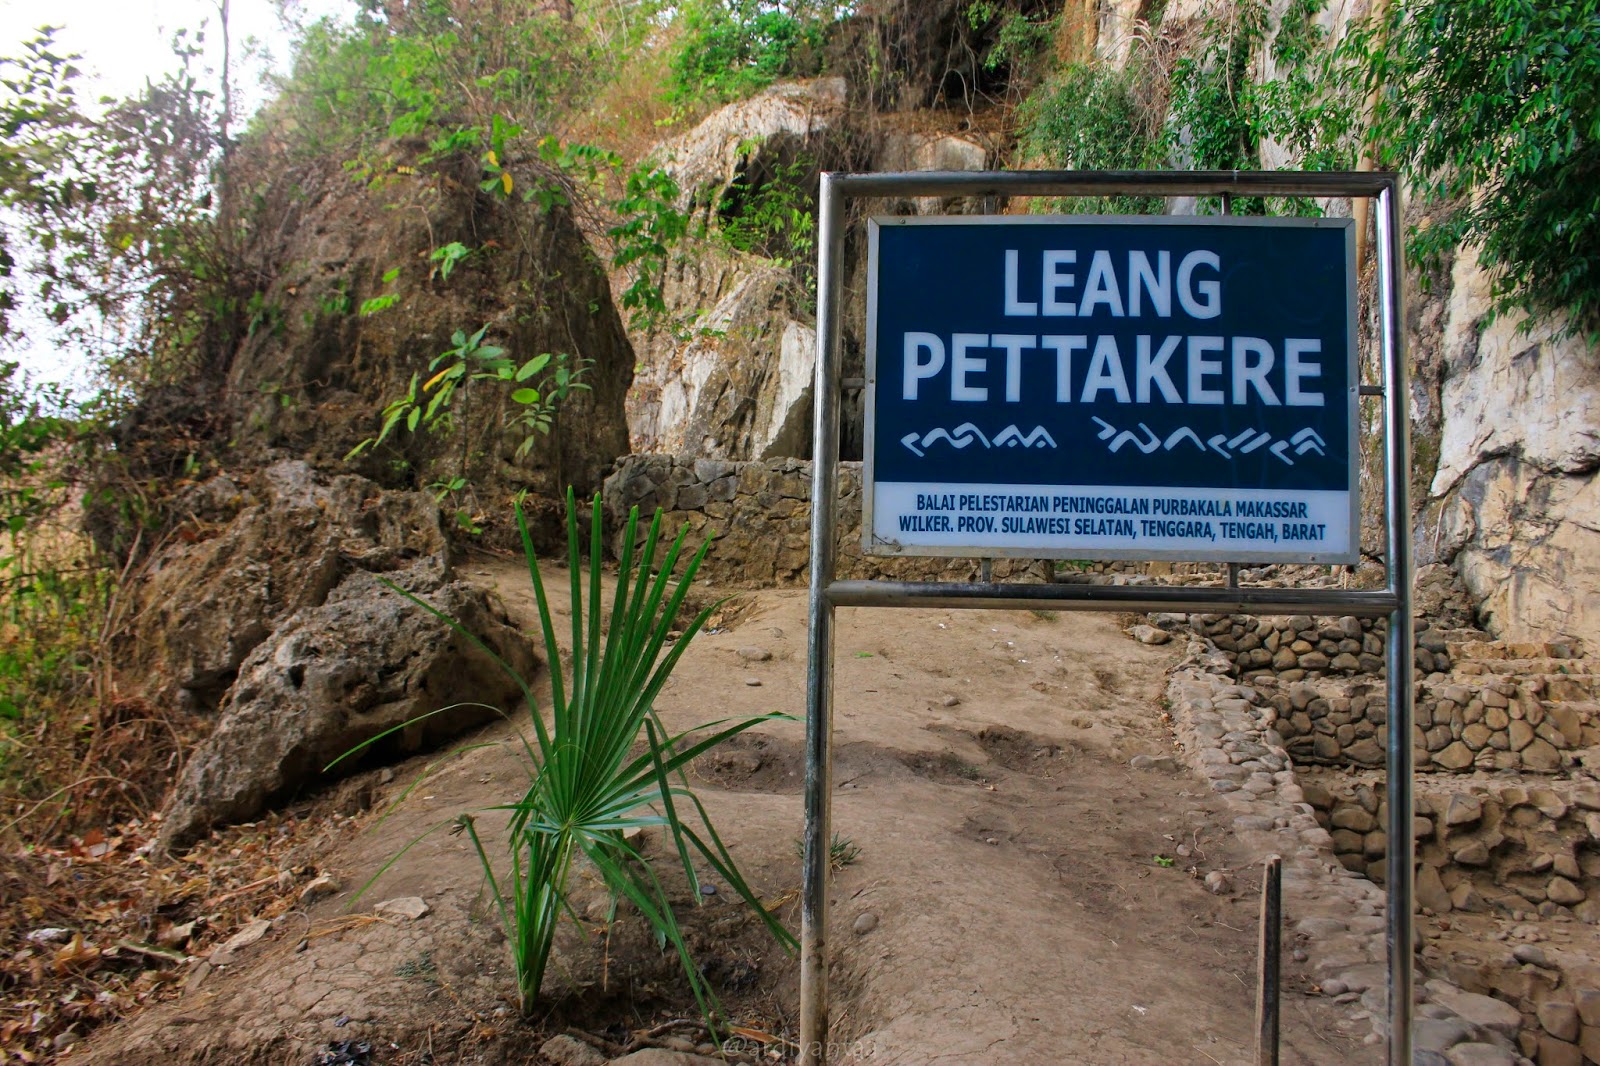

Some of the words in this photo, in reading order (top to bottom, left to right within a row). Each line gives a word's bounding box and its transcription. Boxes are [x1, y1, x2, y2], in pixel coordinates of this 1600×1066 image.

[1004, 249, 1221, 320] LEANG
[902, 331, 1325, 407] PETTAKERE
[899, 515, 953, 532] WILKER.
[958, 516, 998, 533] PROV.
[1001, 517, 1071, 535] SULAWESI
[1074, 519, 1137, 540] SELATAN,
[1141, 519, 1216, 542] TENGGARA,
[1220, 521, 1278, 543] TENGAH,
[1282, 524, 1326, 541] BARAT
[917, 494, 955, 511] BALAI
[960, 495, 1049, 513] PELESTARIAN
[1053, 496, 1149, 515] PENINGGALAN
[1153, 498, 1232, 517] PURBAKALA
[1236, 501, 1308, 519] MAKASSAR
